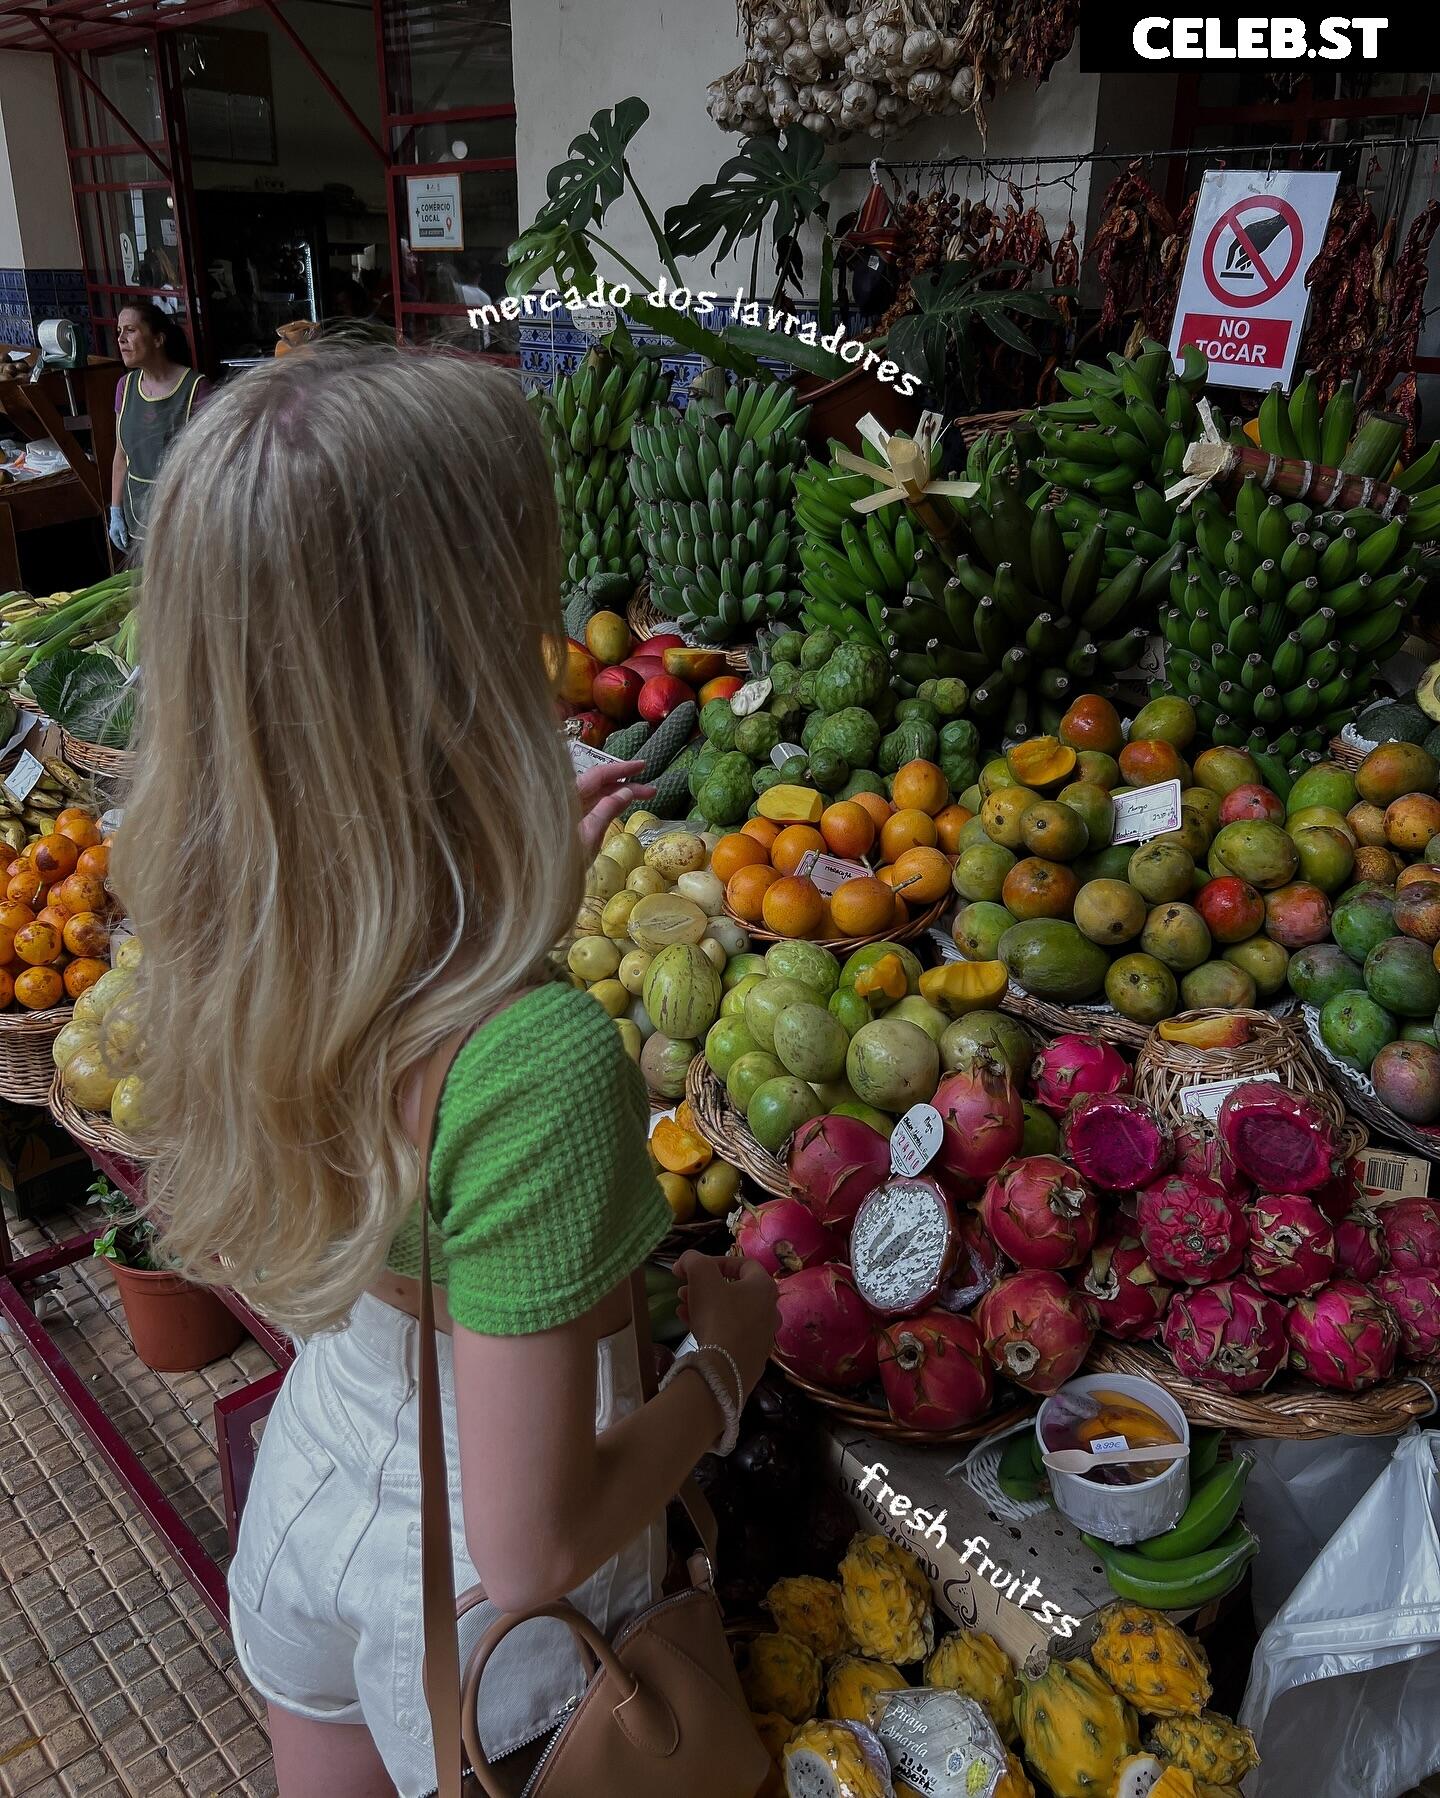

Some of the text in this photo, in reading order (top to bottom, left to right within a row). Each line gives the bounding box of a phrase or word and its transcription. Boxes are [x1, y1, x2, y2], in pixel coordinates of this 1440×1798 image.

[421, 214, 441, 223] LOCAL
[1218, 319, 1250, 339] NO
[1195, 339, 1267, 364] TOCAR
